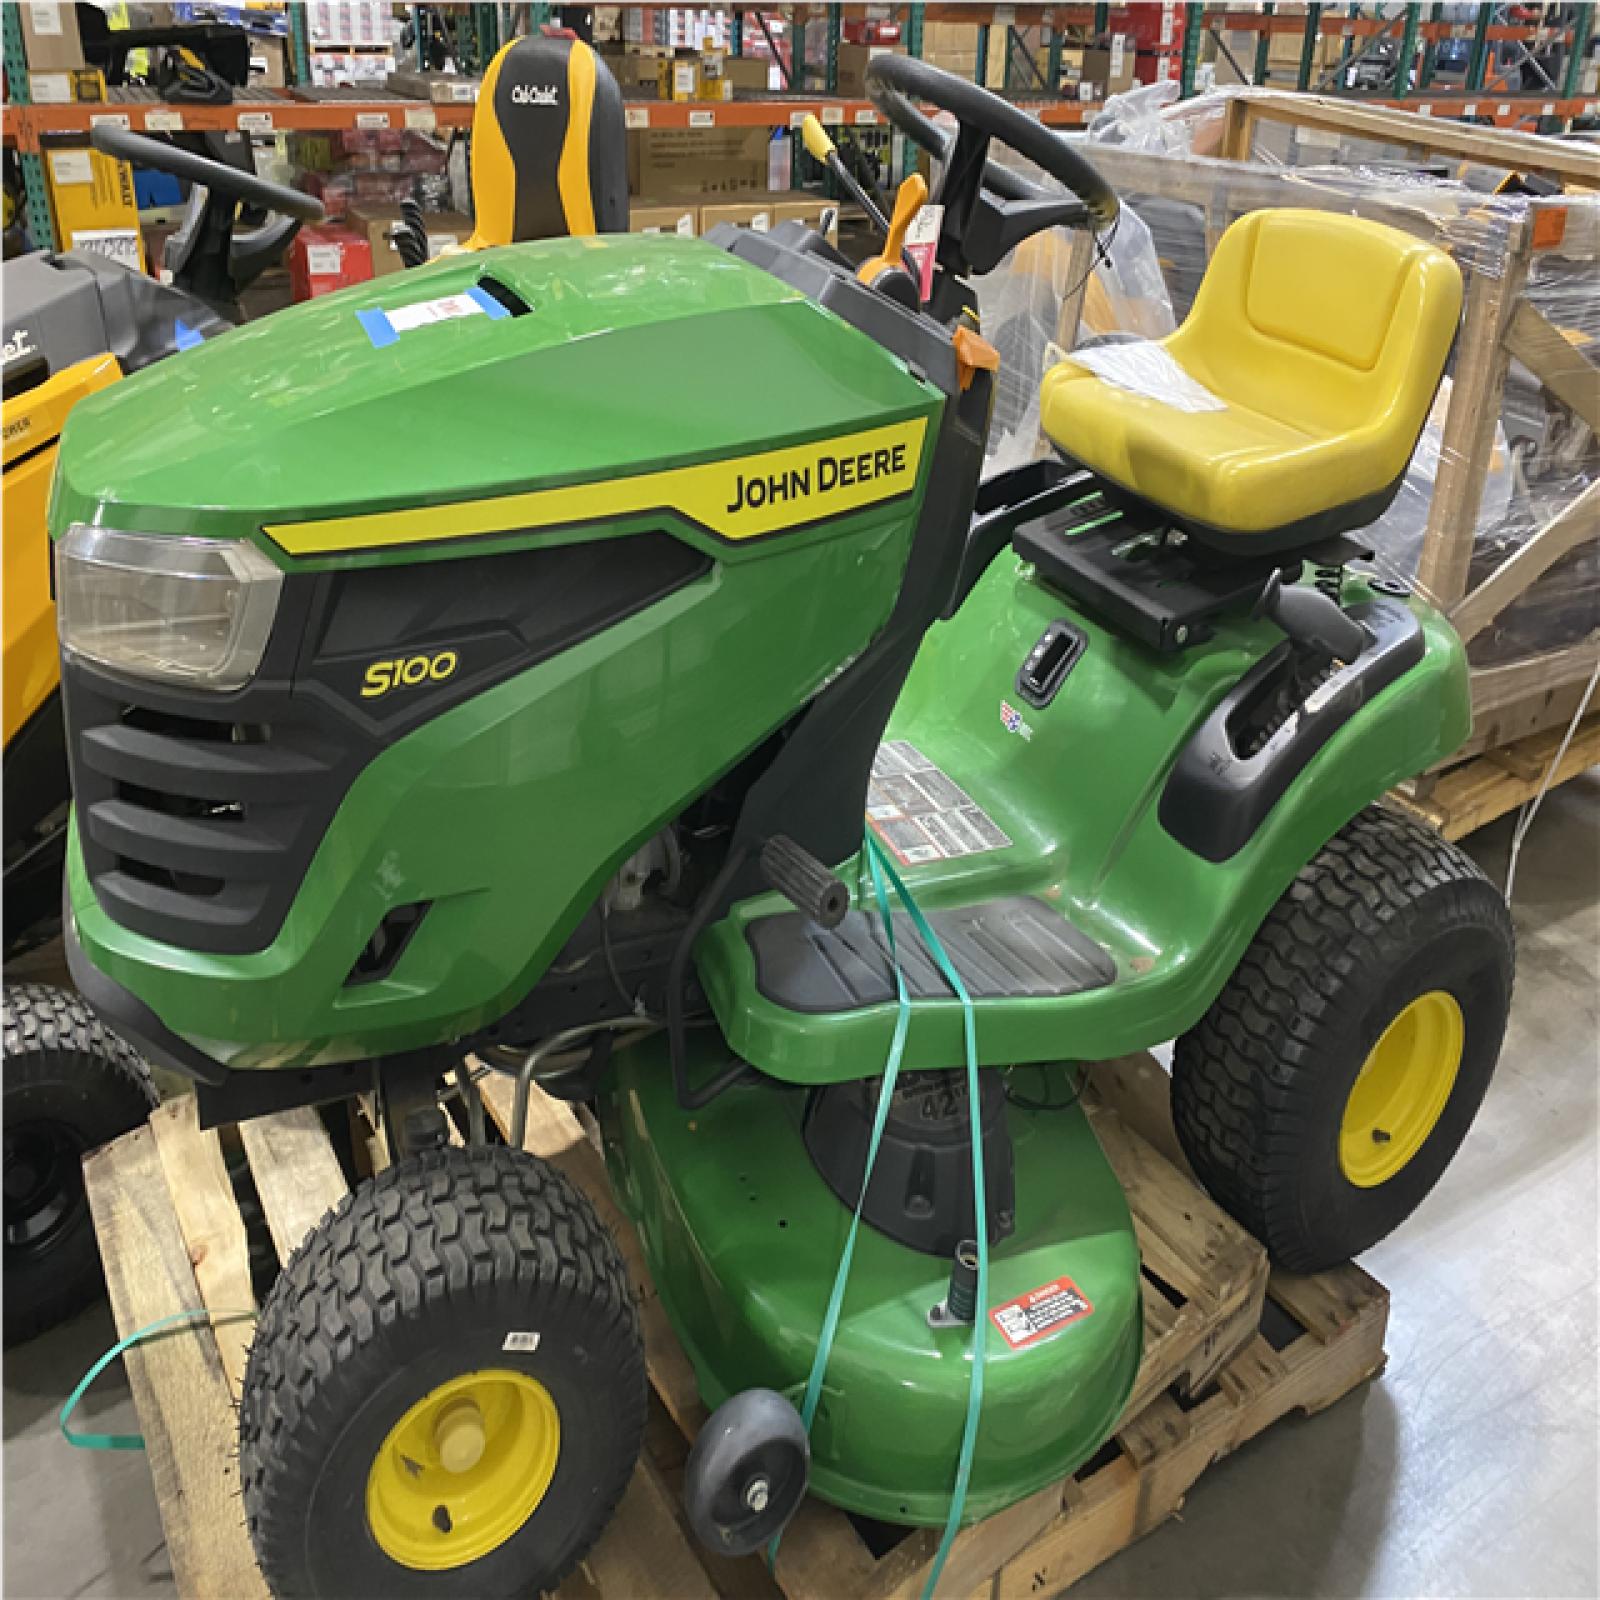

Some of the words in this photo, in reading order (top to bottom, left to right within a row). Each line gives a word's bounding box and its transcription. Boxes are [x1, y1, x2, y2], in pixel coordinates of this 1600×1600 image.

[727, 466, 811, 513] JOHN
[817, 443, 906, 493] DEERE
[361, 651, 457, 696] S100
